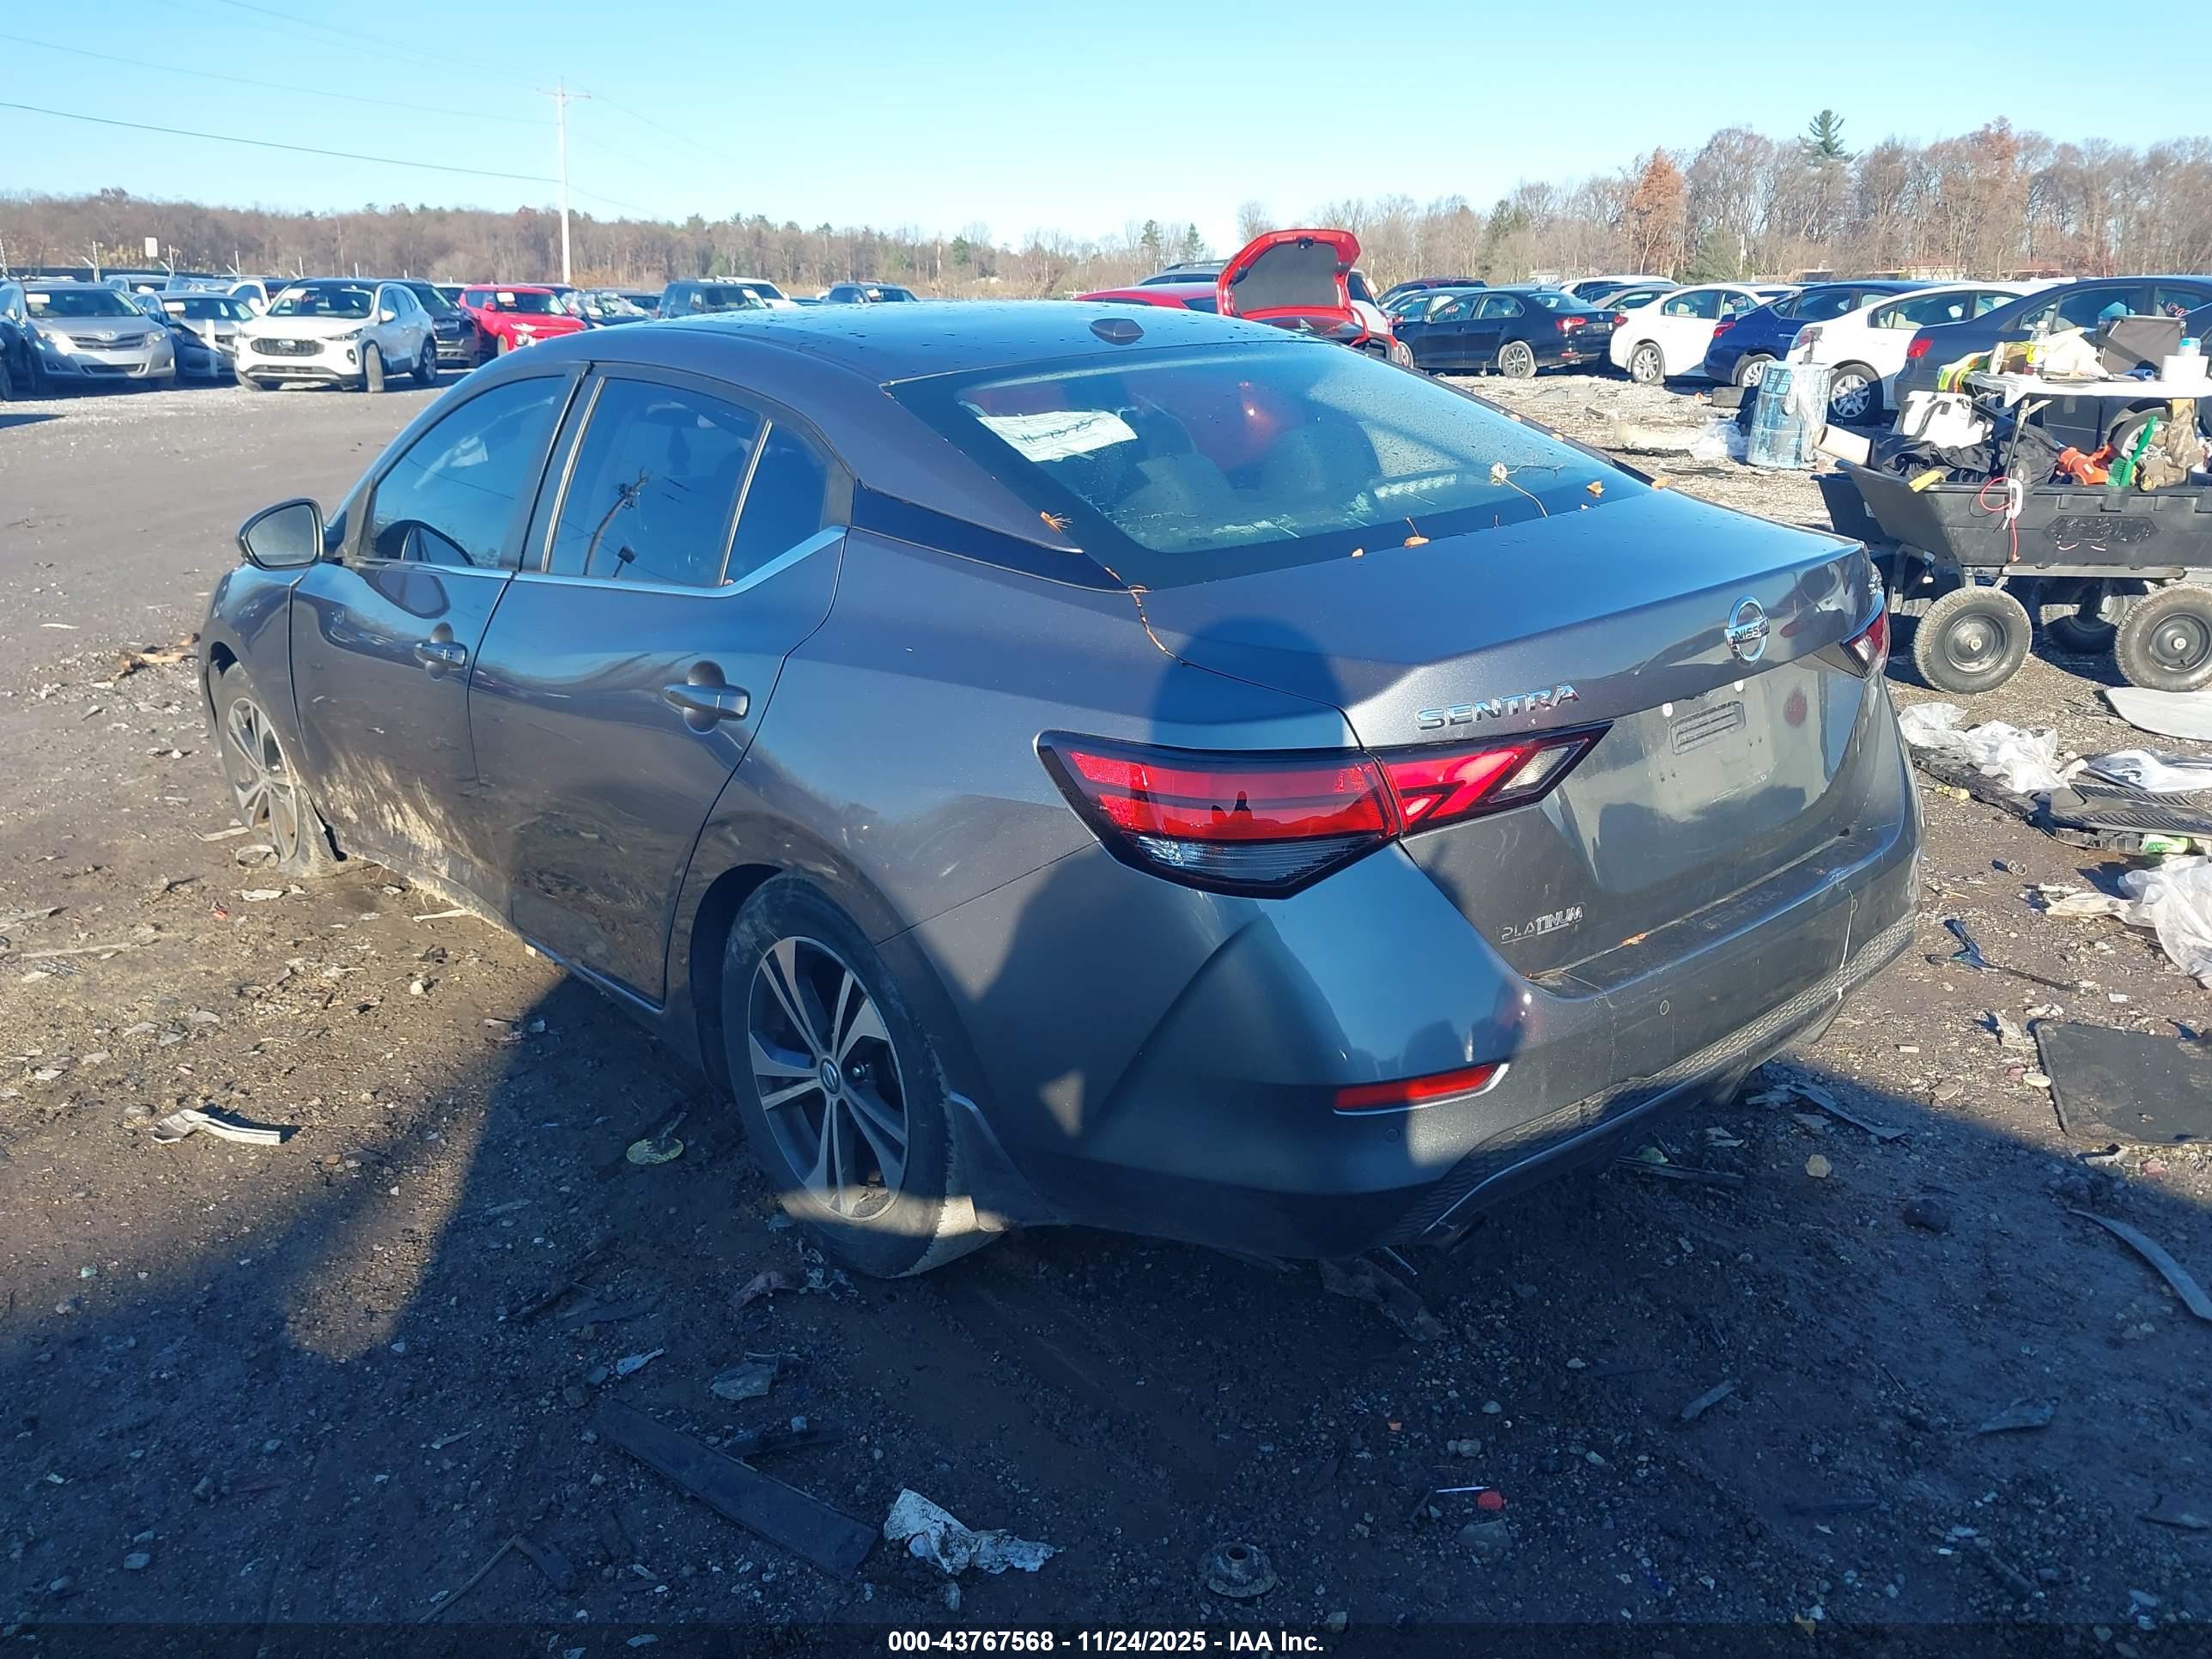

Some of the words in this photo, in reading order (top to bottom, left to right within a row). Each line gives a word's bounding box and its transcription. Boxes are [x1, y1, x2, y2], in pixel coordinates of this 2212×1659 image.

[1734, 621, 1769, 641] NISSAN
[1416, 683, 1580, 731] SENTRA
[1501, 906, 1583, 941] PLATINUM
